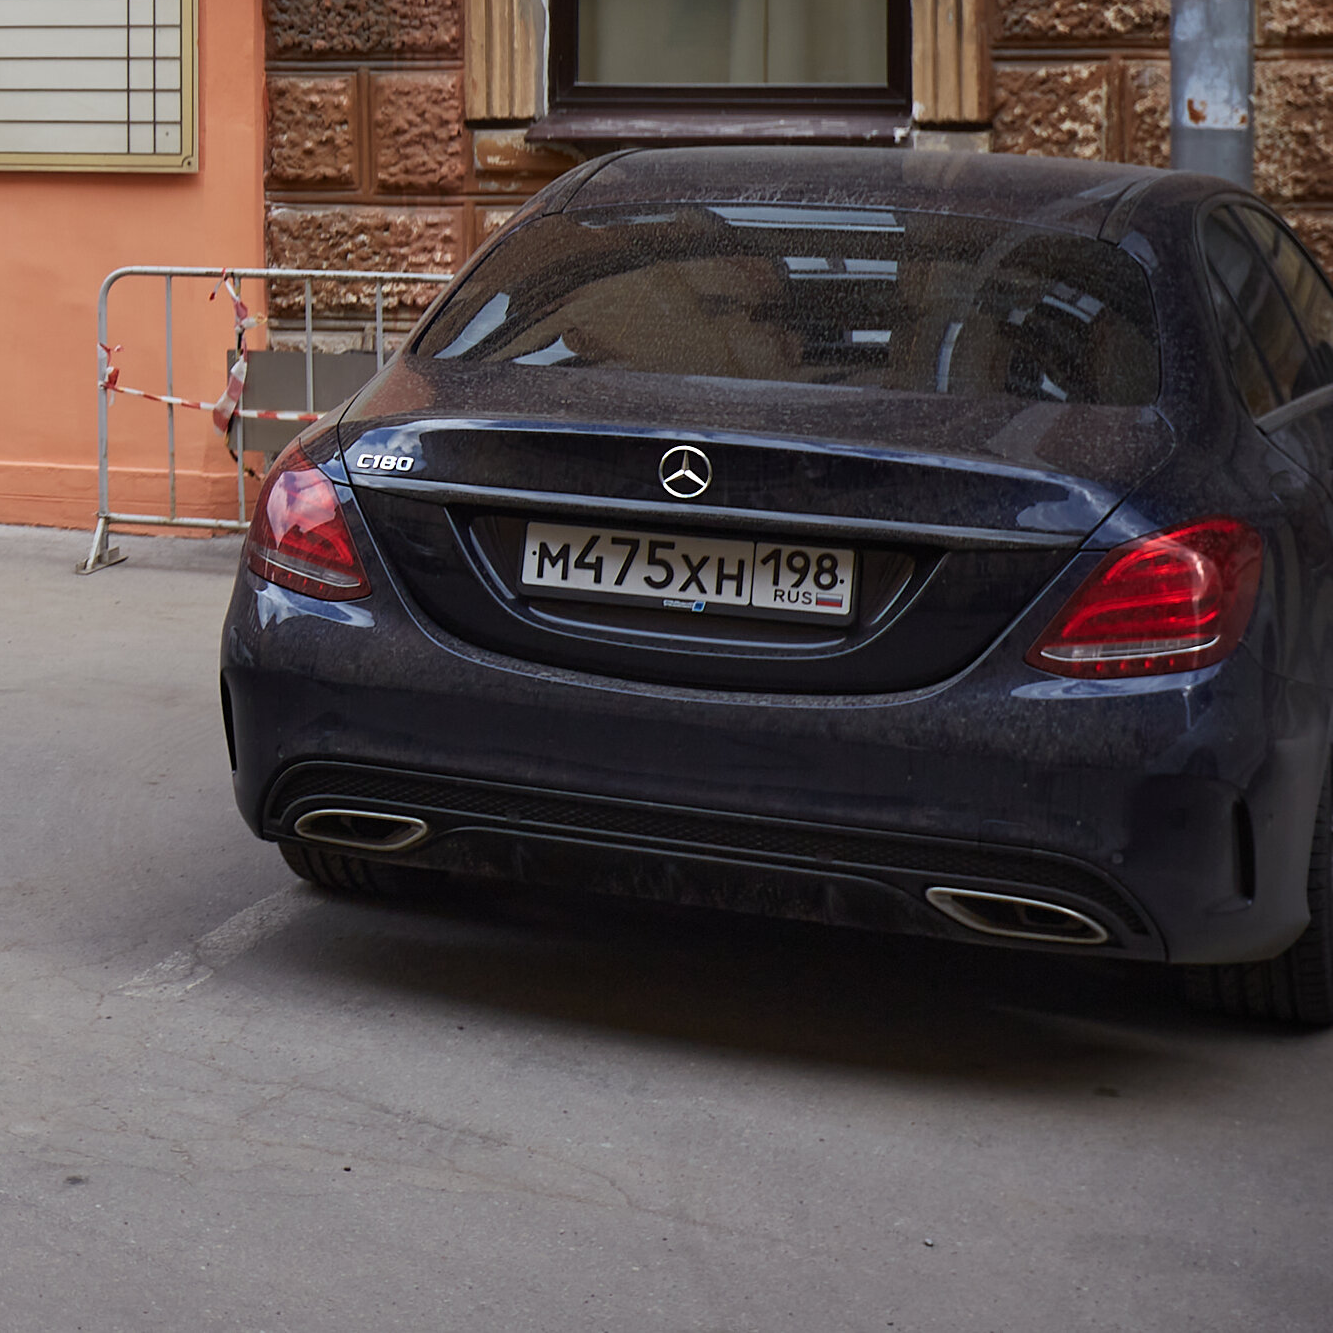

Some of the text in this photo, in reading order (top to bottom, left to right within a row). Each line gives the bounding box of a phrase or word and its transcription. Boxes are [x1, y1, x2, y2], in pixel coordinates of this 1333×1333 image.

[356, 453, 415, 472] C180
[760, 547, 839, 591] 198
[773, 589, 813, 605] RUS
